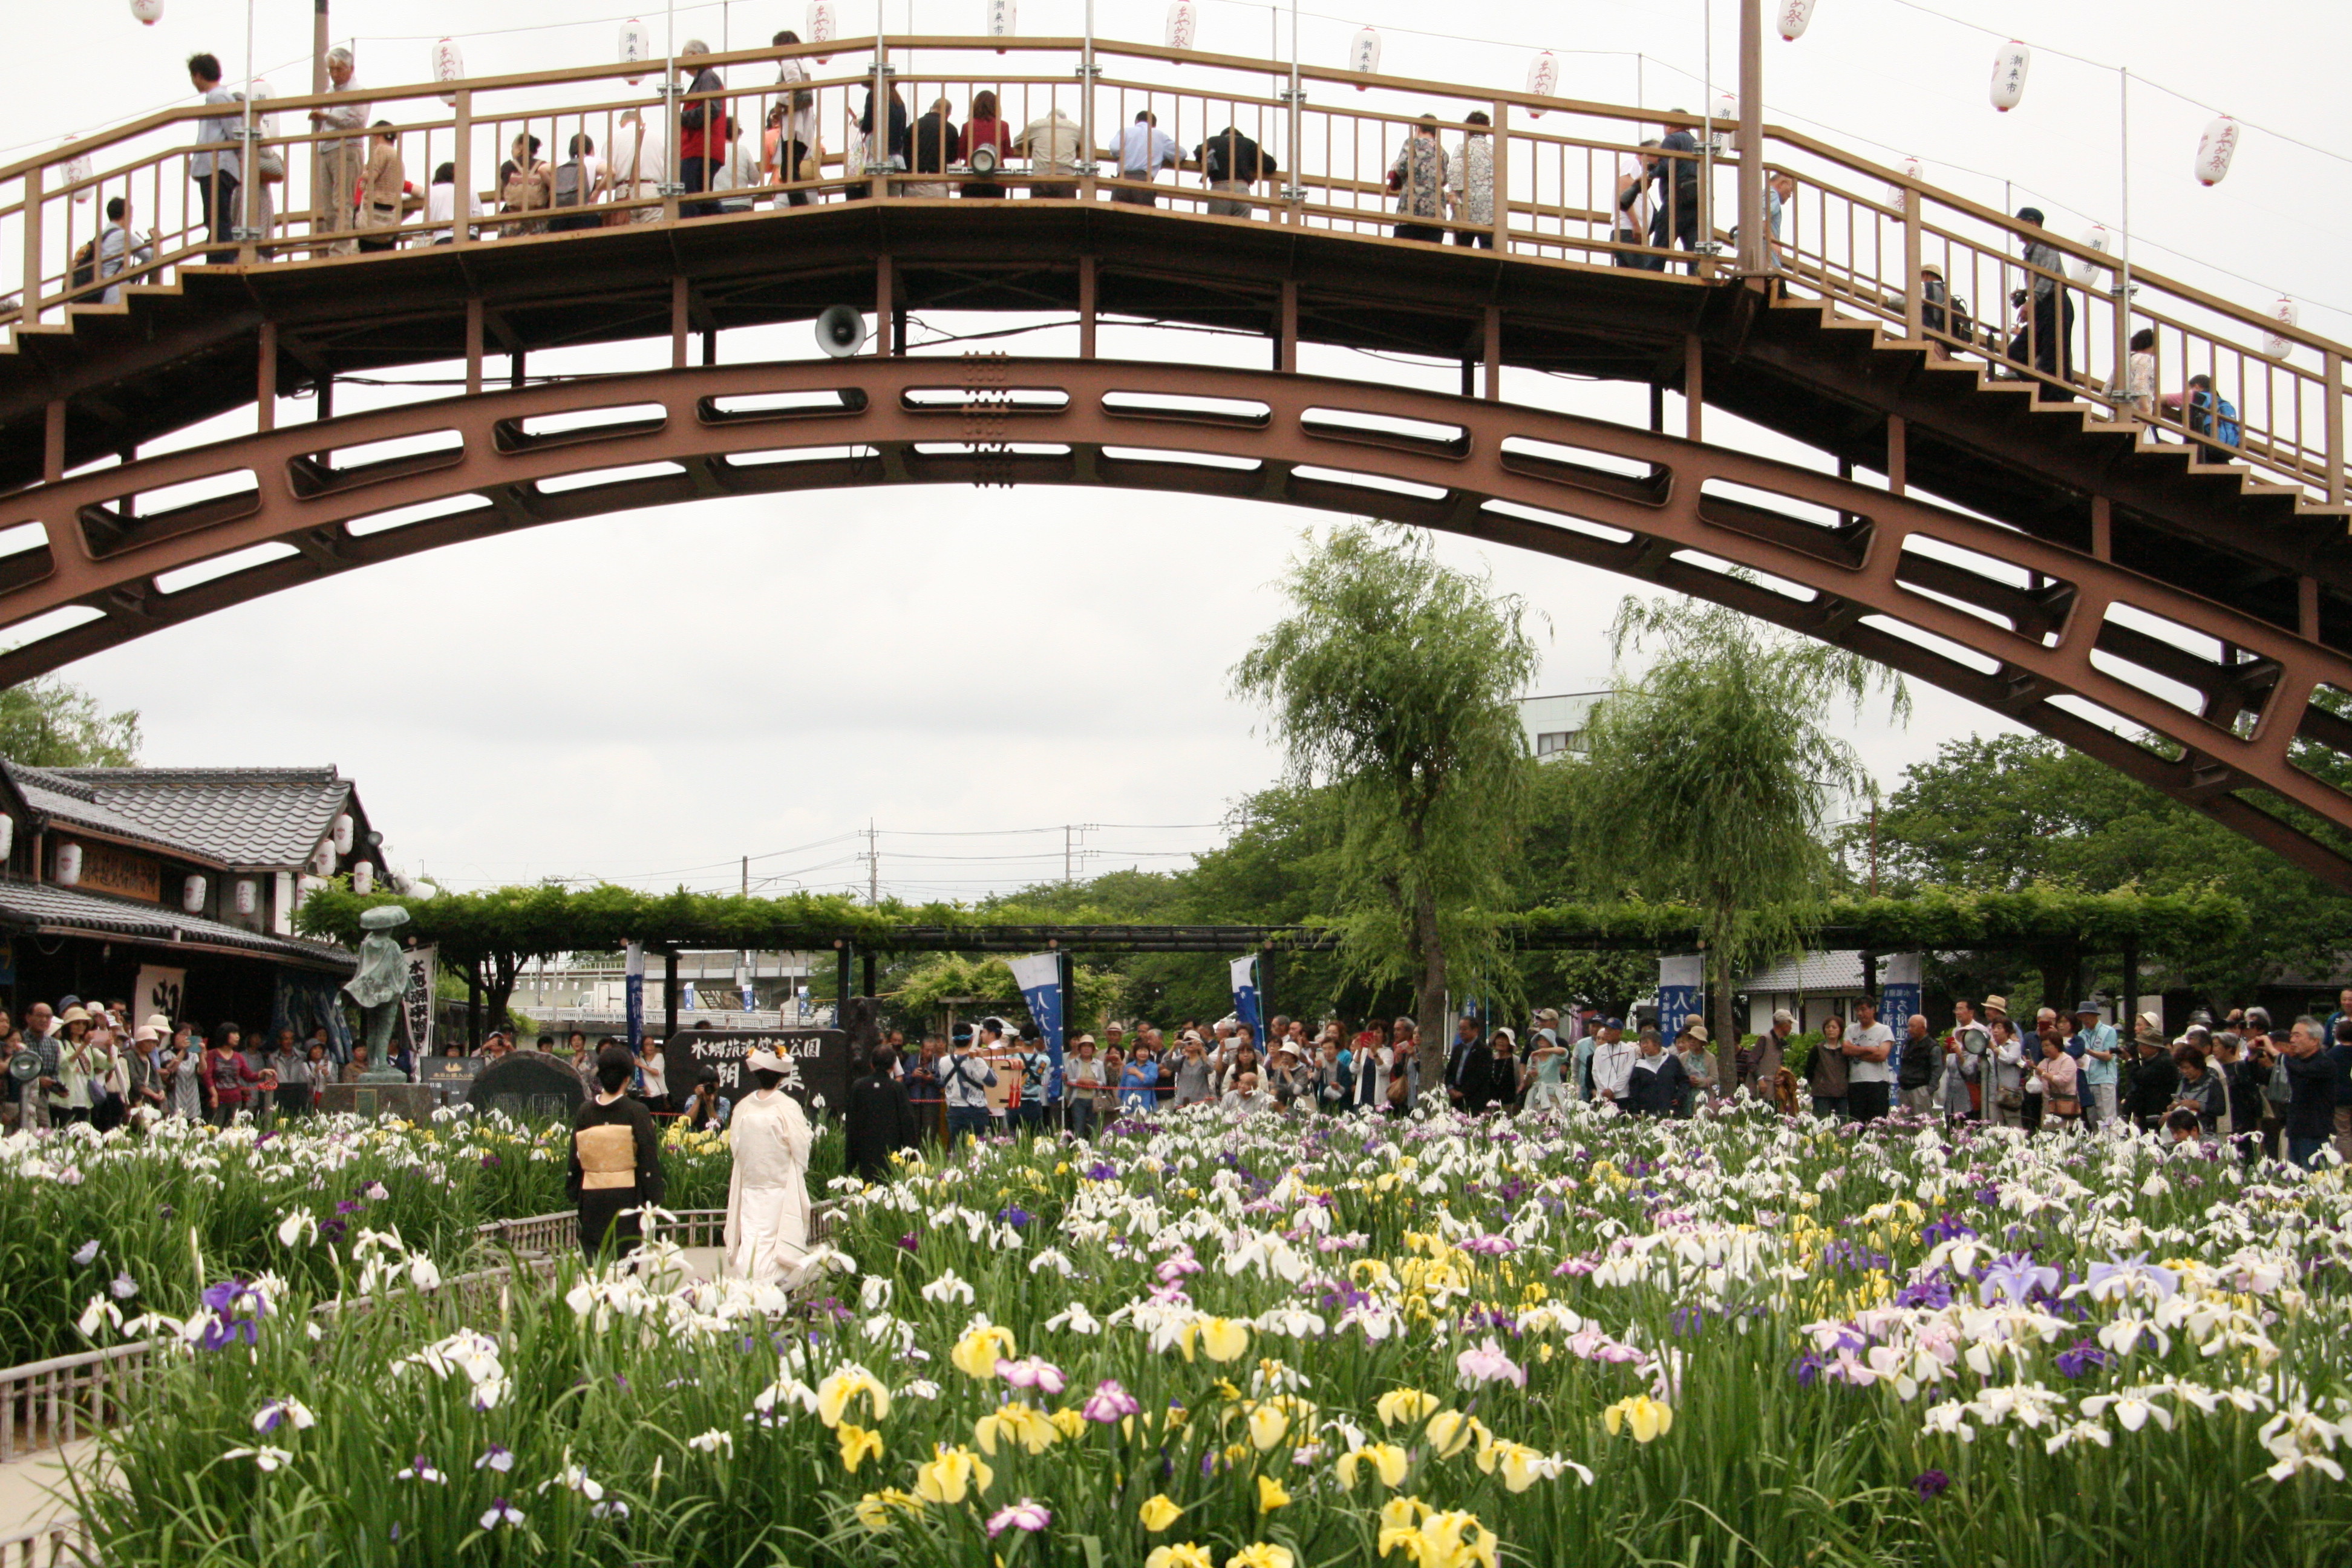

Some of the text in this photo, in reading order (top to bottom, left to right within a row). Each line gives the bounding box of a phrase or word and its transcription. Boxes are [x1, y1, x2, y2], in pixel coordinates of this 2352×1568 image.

[993, 0, 1005, 36] 潮来市
[439, 47, 456, 83] あやめ
[1357, 40, 1373, 73] 潮来市
[2005, 54, 2023, 95] 潮来市
[1712, 108, 1731, 144] 潮市
[2206, 125, 2233, 173] あやめ祭
[2083, 238, 2102, 274] 潮市
